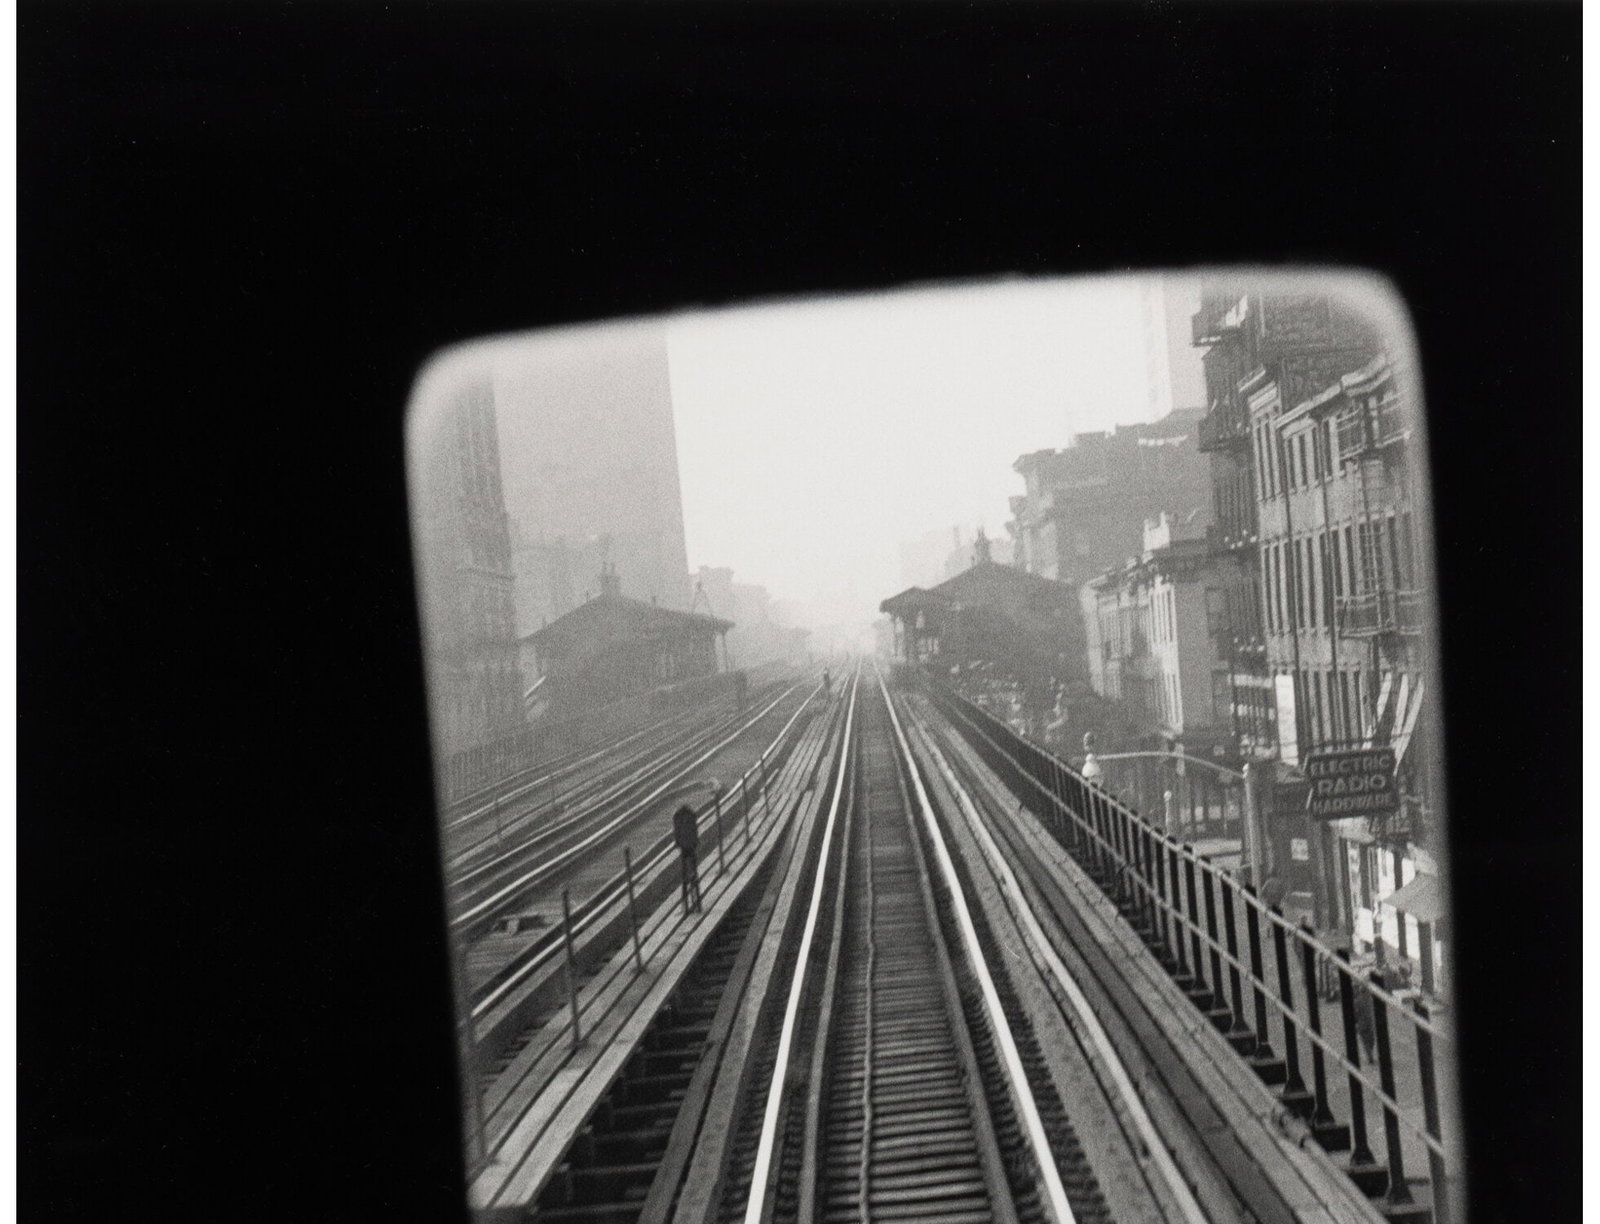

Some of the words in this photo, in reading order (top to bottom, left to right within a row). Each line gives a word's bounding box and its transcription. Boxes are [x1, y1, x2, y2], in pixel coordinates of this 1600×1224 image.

[1310, 755, 1391, 777] ELECTRIC
[1317, 773, 1386, 795] RADIO
[1312, 792, 1395, 814] HARDWARE
